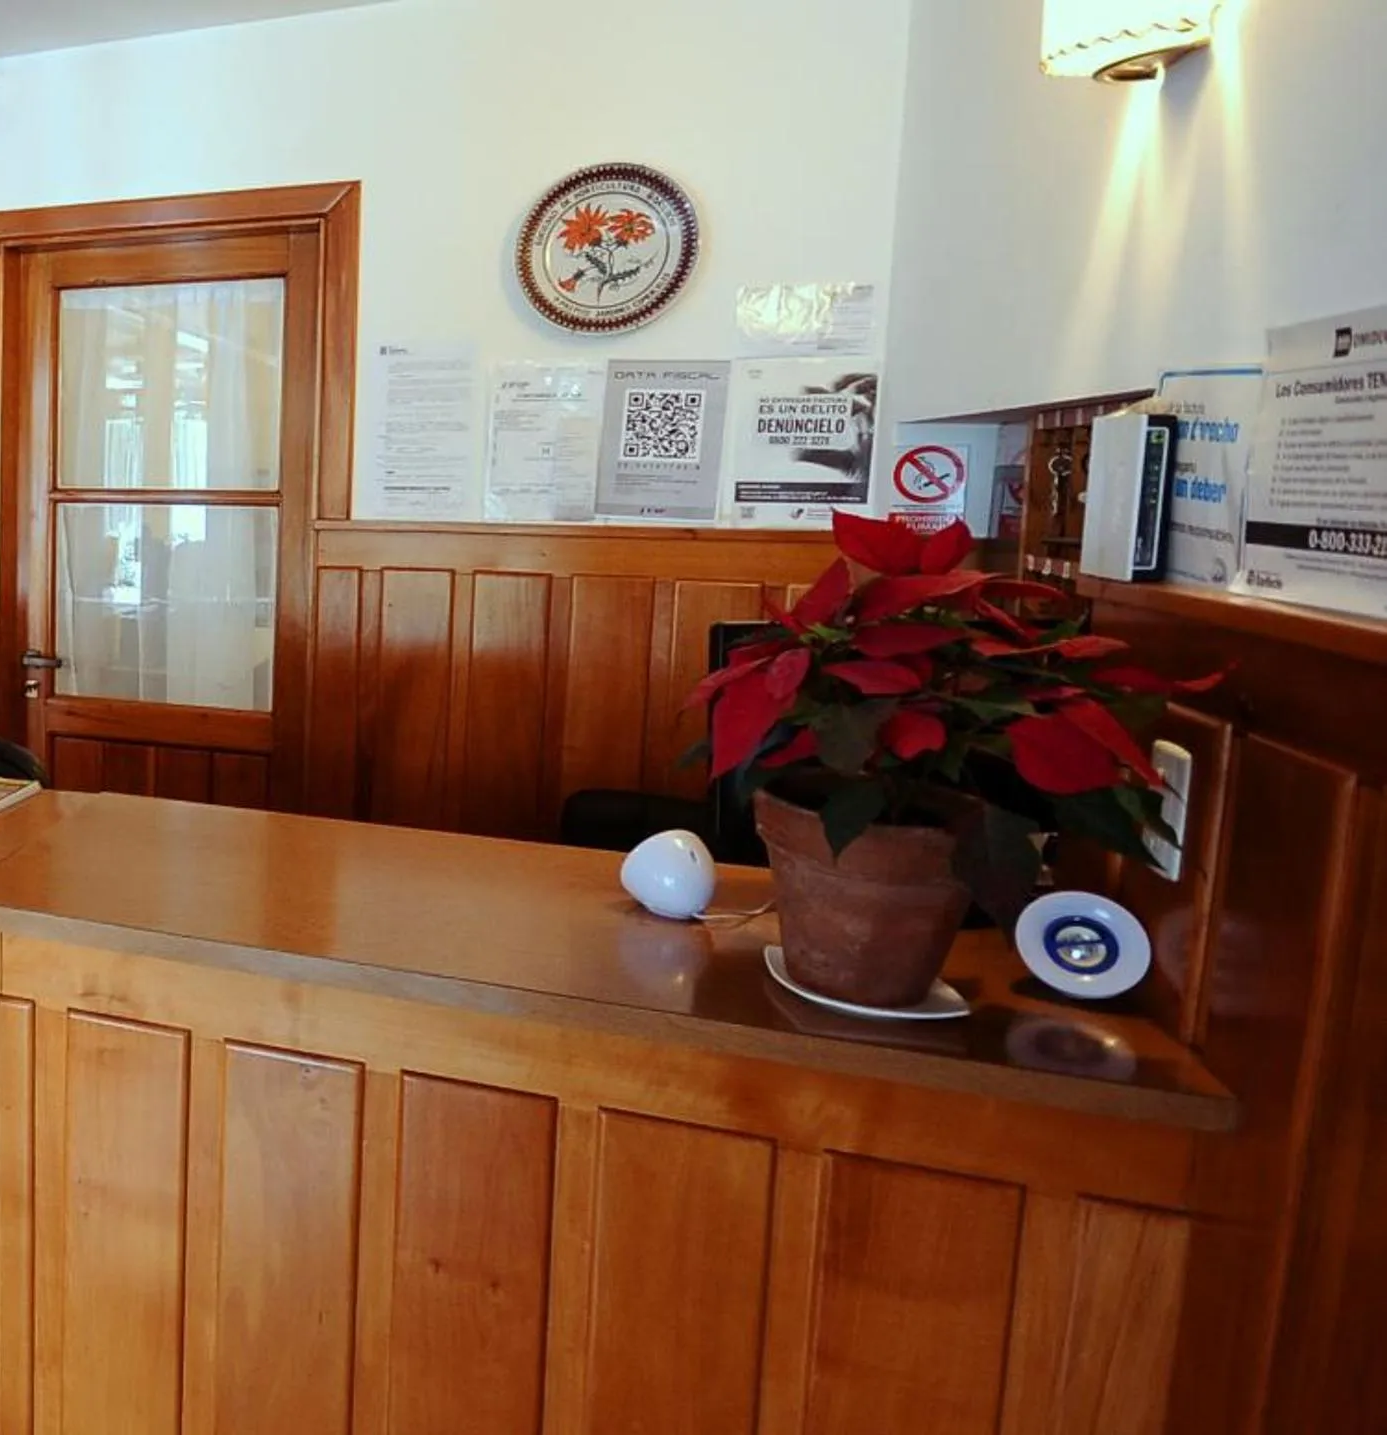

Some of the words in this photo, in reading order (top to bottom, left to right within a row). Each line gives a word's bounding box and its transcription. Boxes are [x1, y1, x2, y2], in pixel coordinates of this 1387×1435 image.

[759, 404, 774, 415] ES
[778, 404, 796, 415] UN
[800, 404, 848, 414] DELITO
